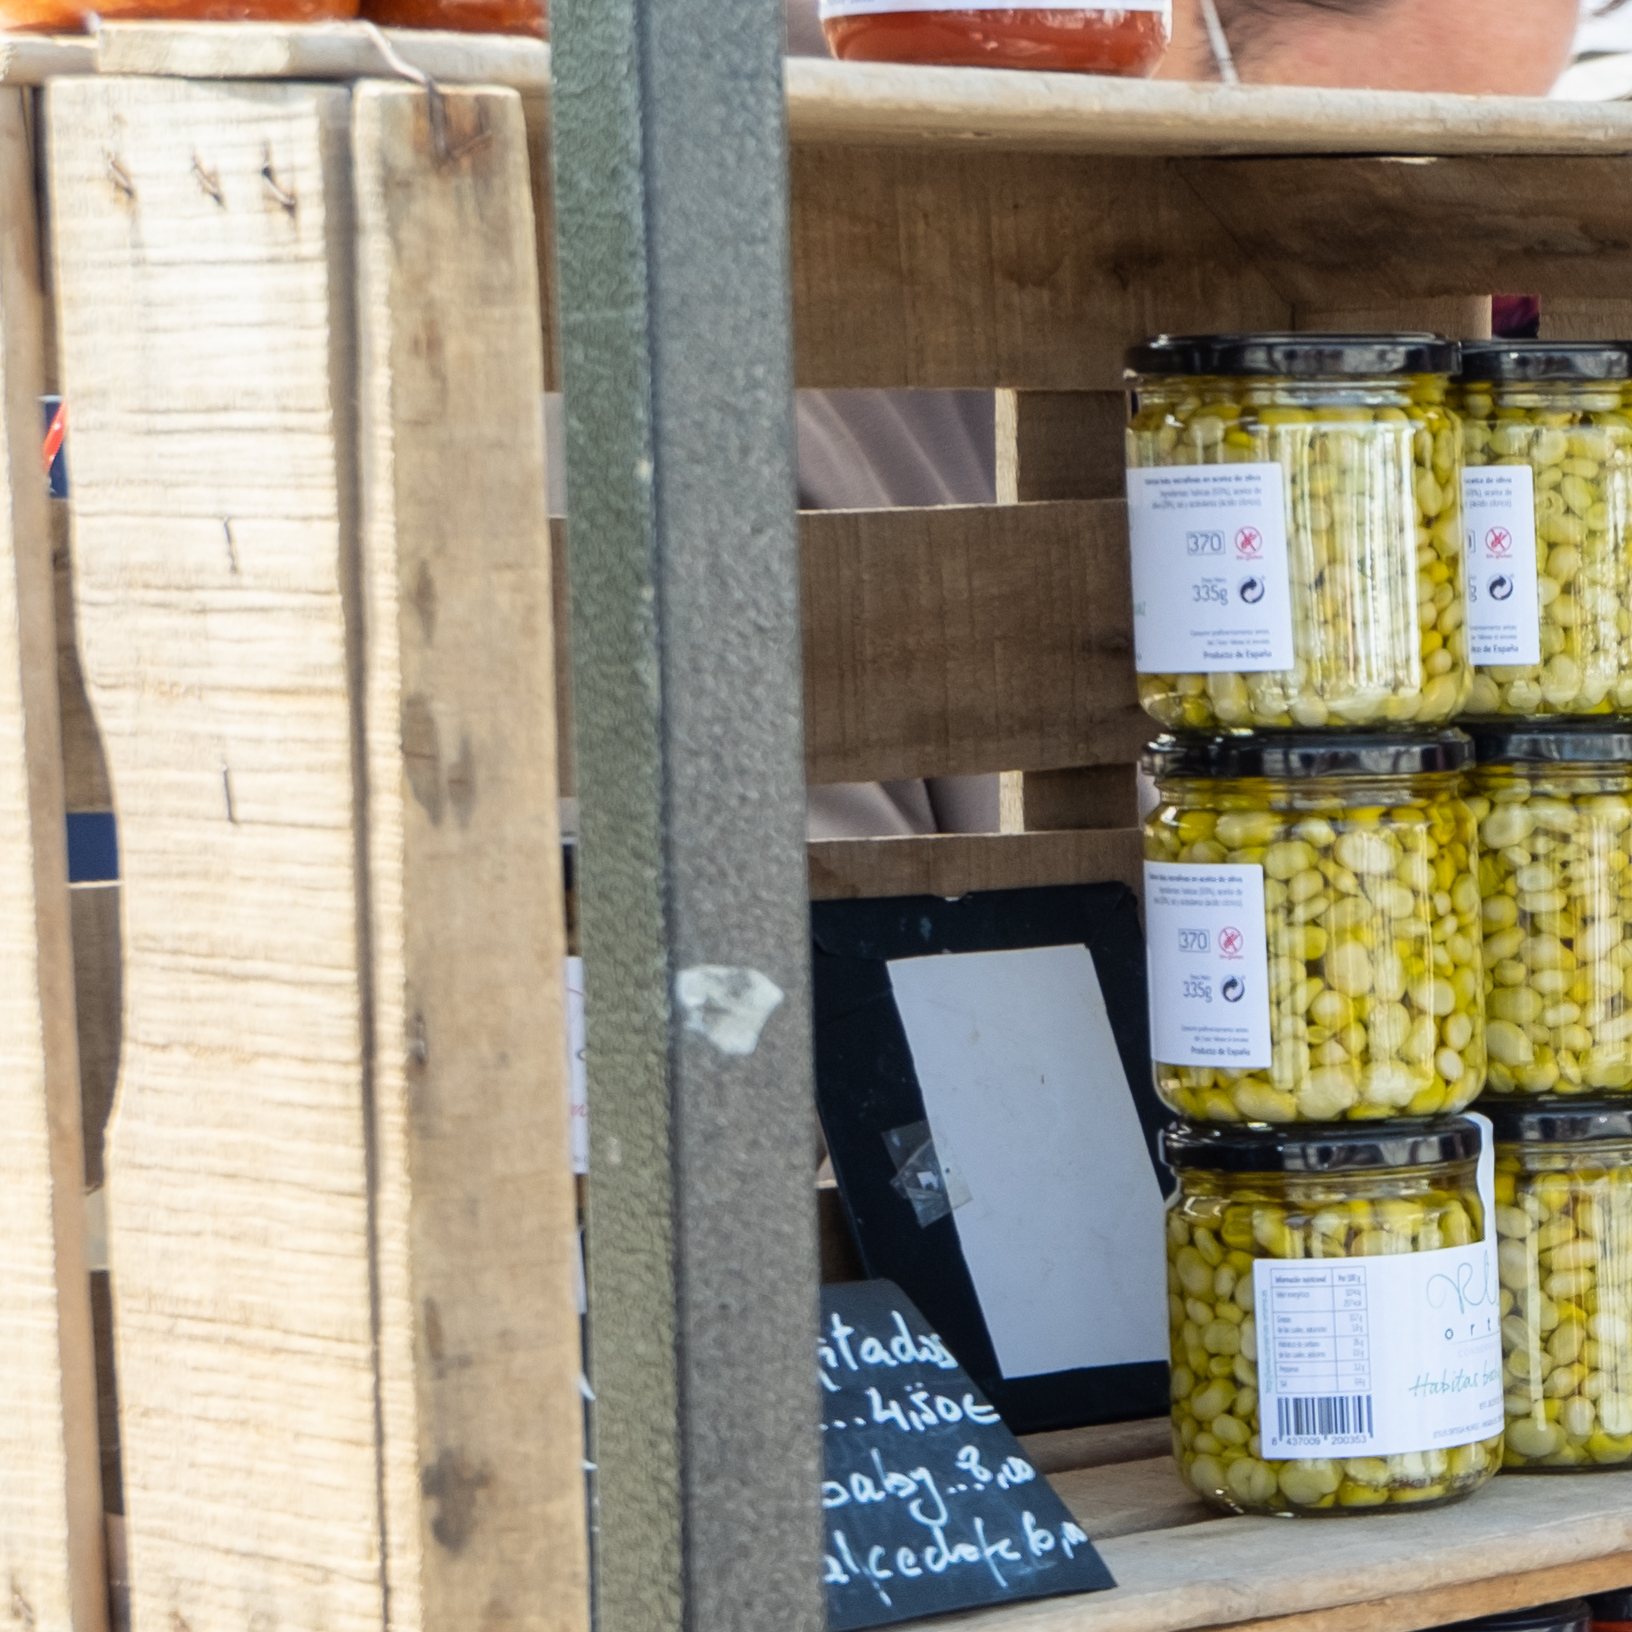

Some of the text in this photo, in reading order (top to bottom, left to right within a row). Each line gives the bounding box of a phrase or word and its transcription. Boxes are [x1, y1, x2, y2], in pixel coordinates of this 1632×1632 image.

[1189, 533, 1222, 551] 370
[1192, 585, 1228, 605] 335g
[1180, 932, 1207, 949] 370
[1183, 981, 1212, 1003] 335g
